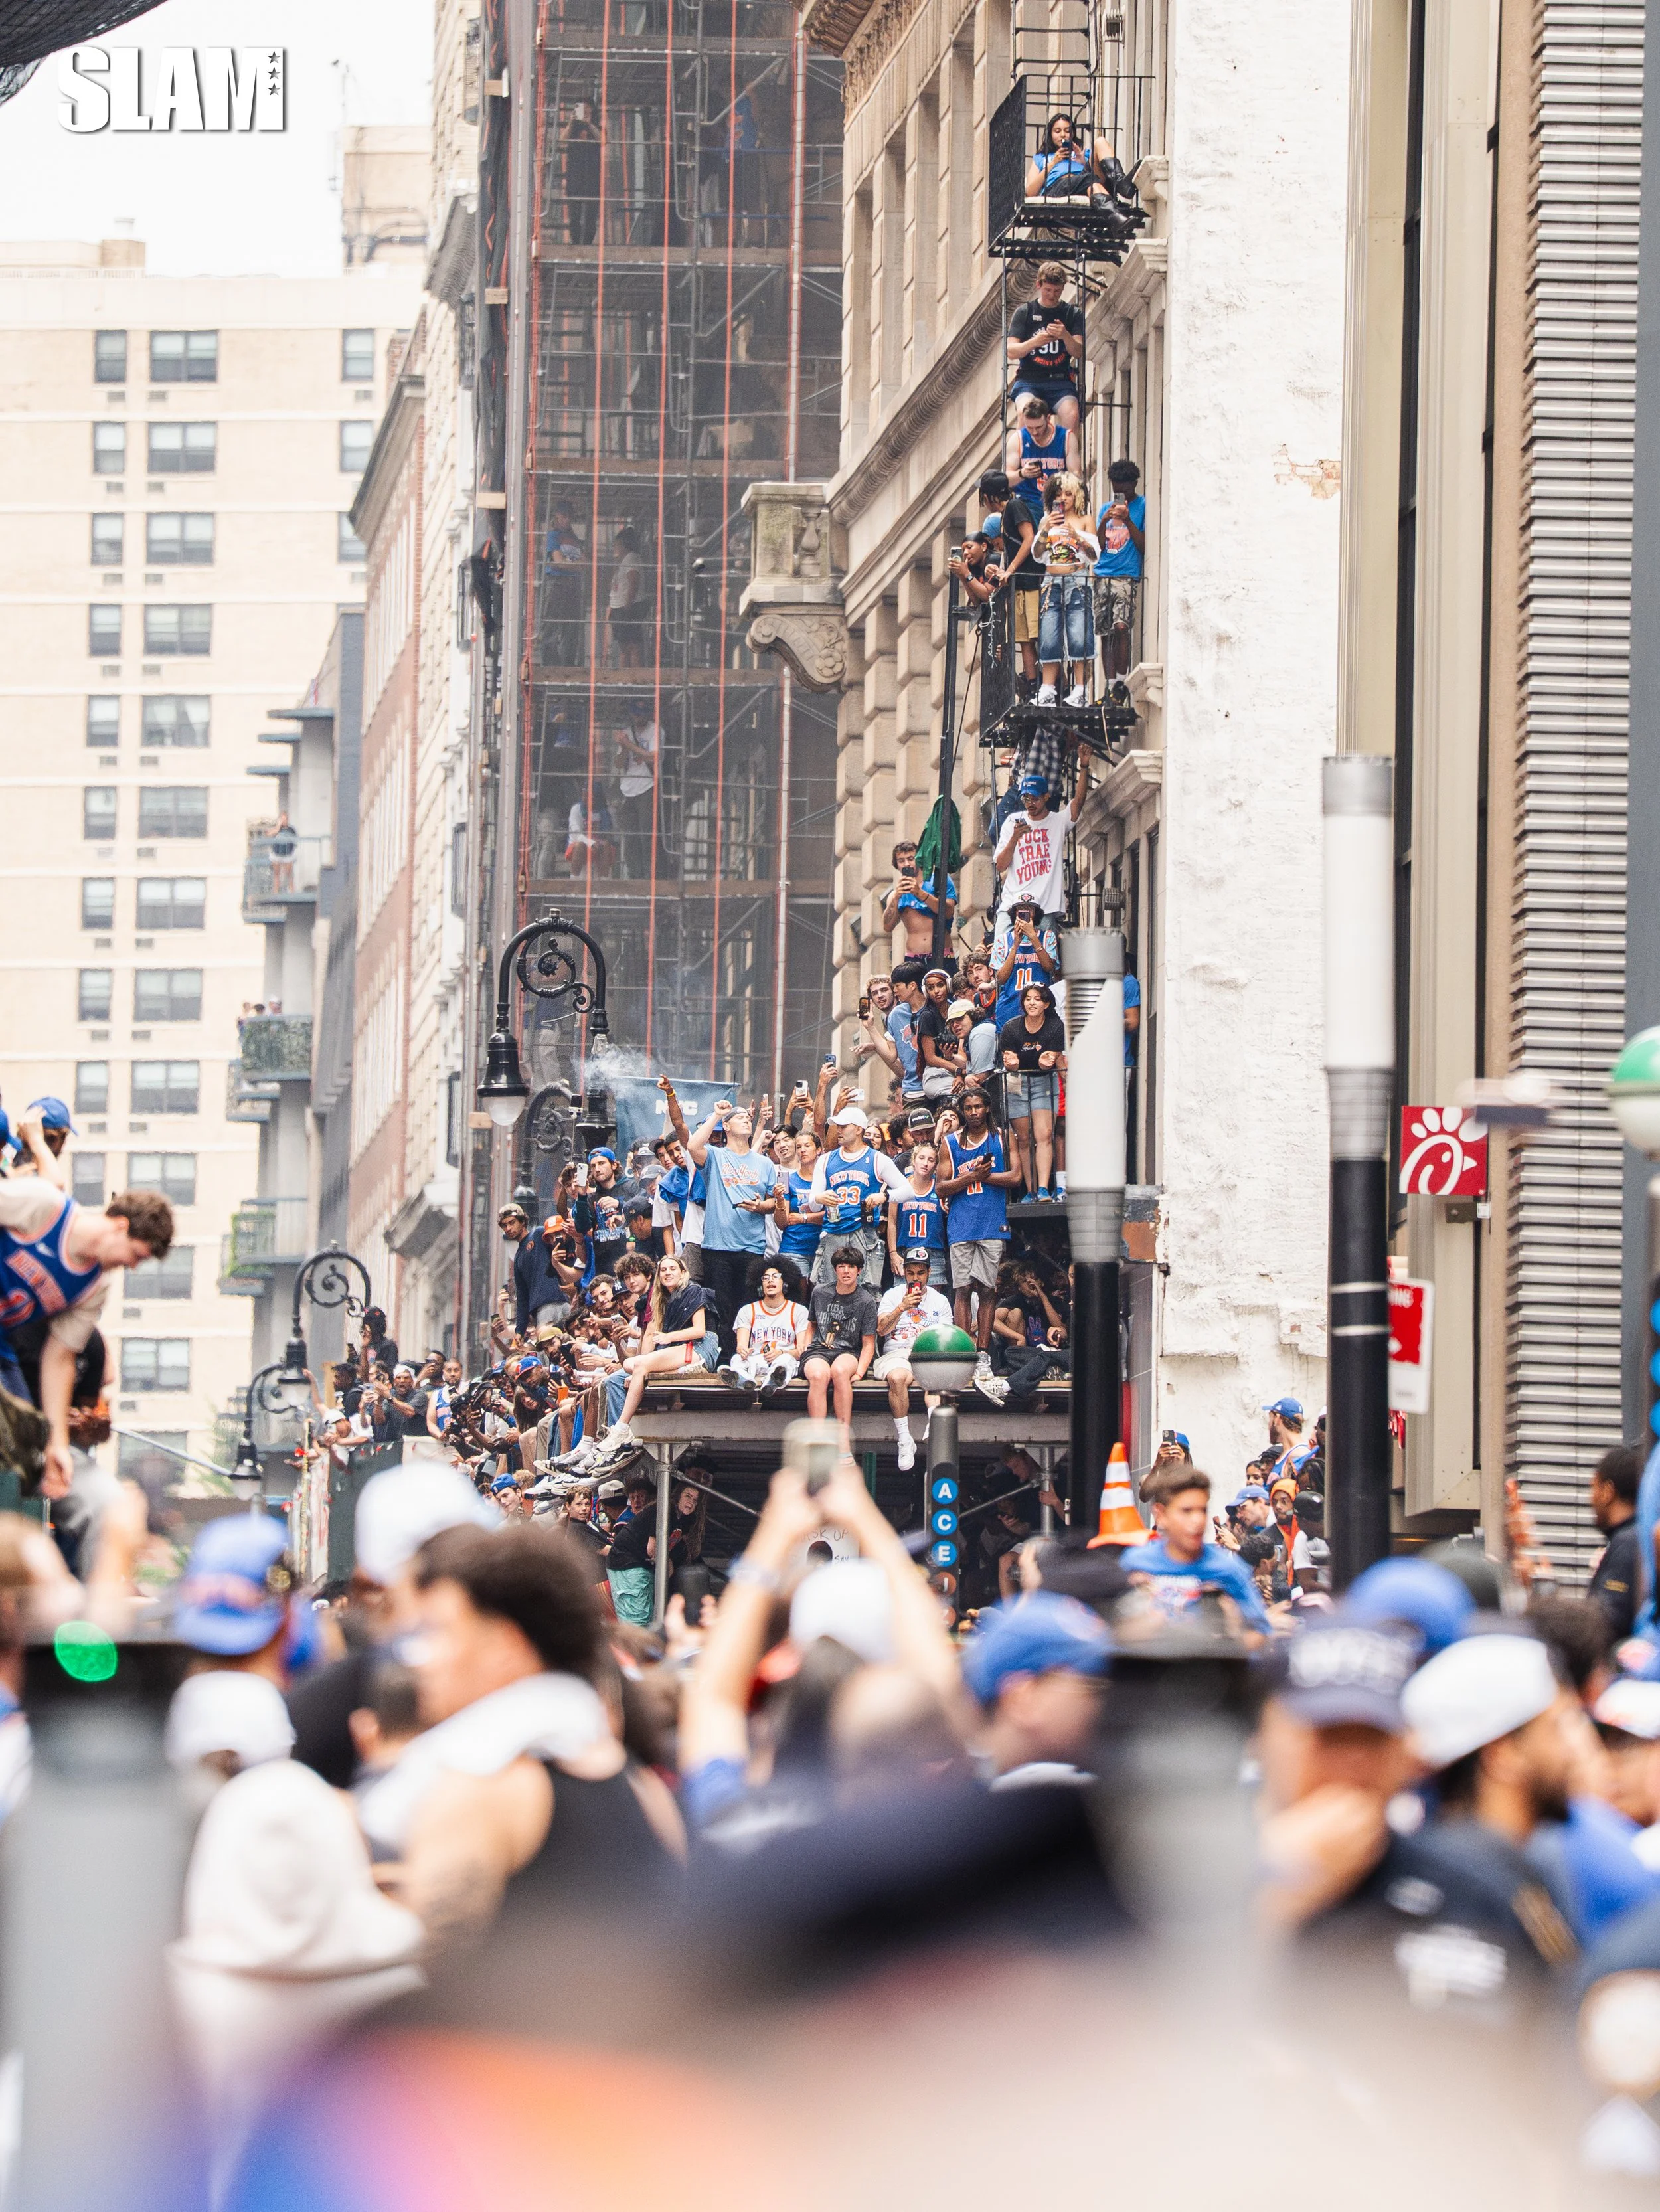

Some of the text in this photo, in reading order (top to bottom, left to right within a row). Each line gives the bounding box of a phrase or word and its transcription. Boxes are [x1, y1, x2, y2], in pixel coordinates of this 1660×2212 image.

[1019, 843, 1050, 865] TRAE
[1016, 859, 1052, 885] YOUNG
[1015, 968, 1033, 991] 11
[655, 1099, 698, 1116] NC
[829, 1169, 870, 1188] NEW YORK
[837, 1186, 861, 1205] 33
[902, 1201, 937, 1213] NEW YORK
[908, 1213, 927, 1238] 11
[752, 1327, 791, 1345] NEW YORK
[938, 1483, 952, 1499] A
[938, 1514, 952, 1531] C
[938, 1545, 951, 1562] E
